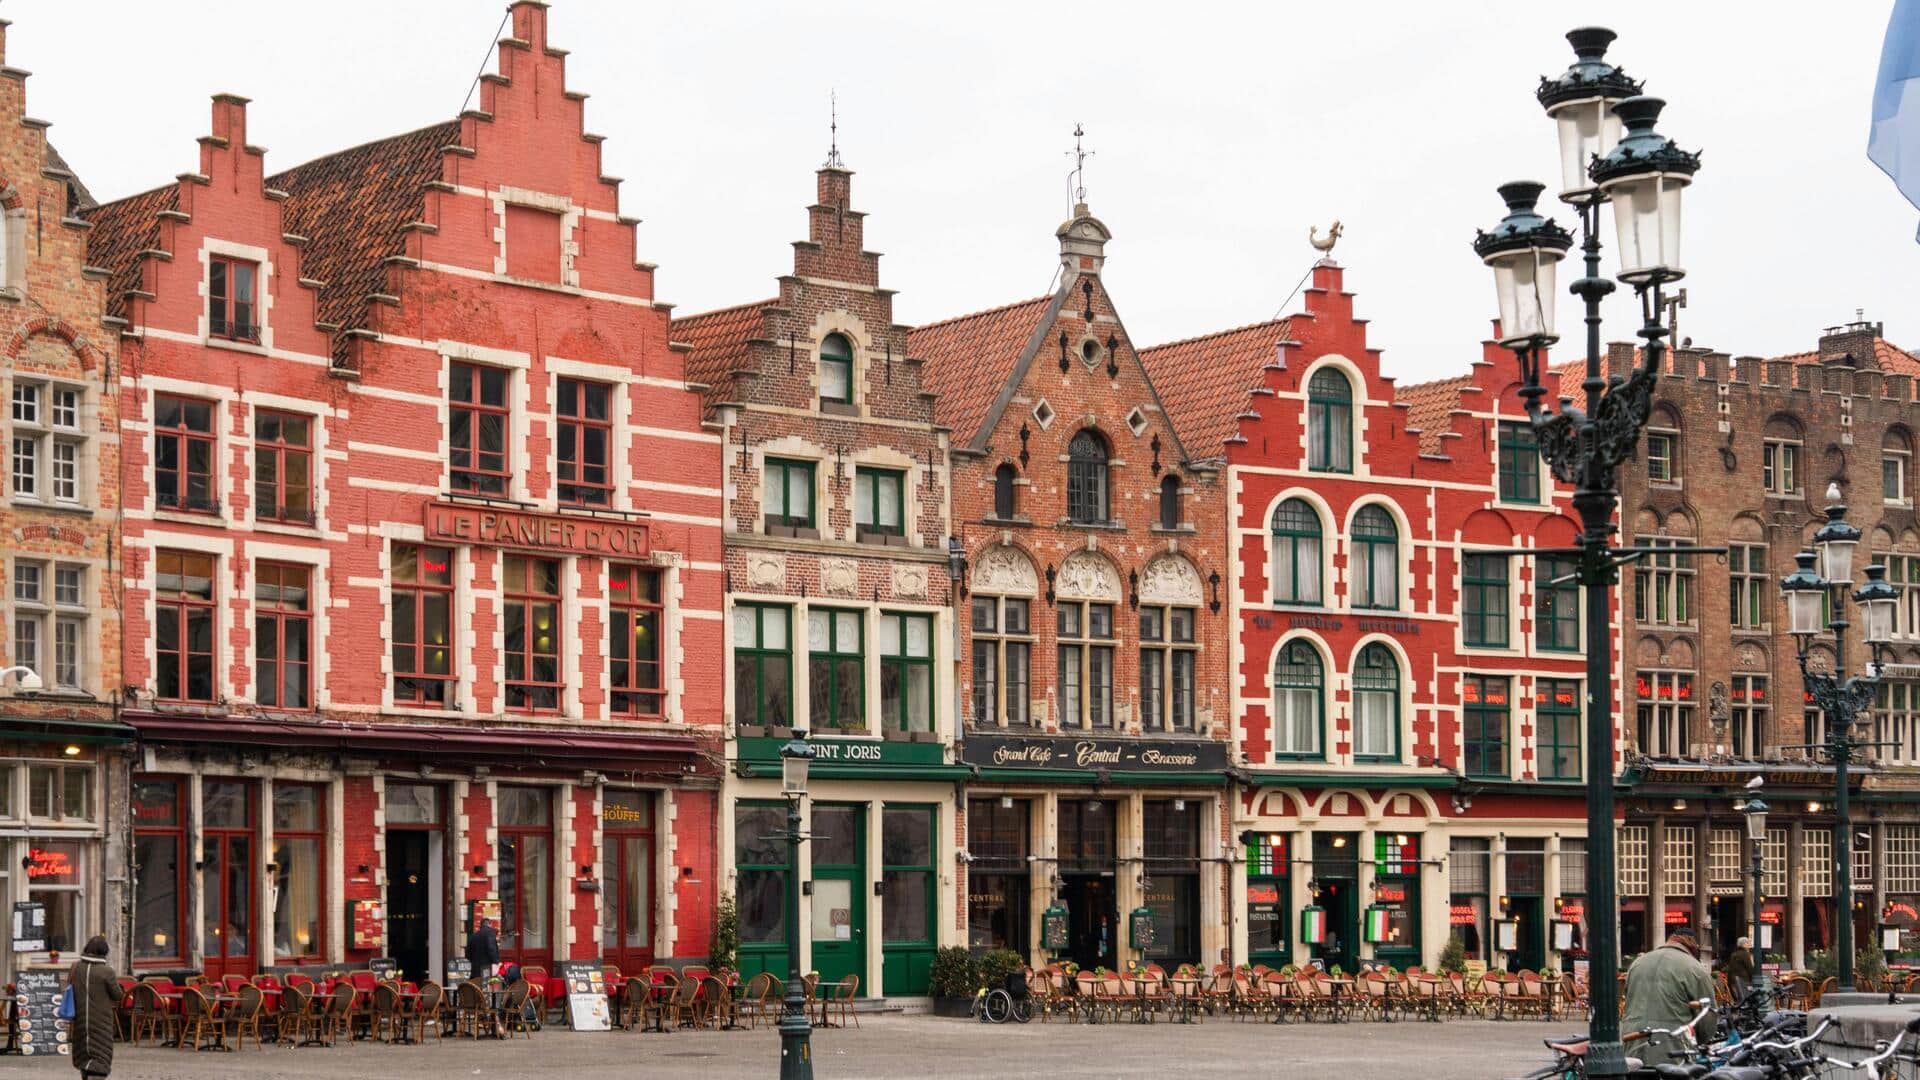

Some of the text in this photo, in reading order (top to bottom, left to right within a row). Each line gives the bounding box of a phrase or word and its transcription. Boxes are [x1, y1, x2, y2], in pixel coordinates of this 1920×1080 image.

[437, 511, 472, 539] LE
[479, 512, 577, 549] PANIER
[844, 745, 882, 760] JORIS
[993, 745, 1029, 765] Grand
[1075, 741, 1122, 767] Central
[1141, 749, 1198, 766] Brasserie
[602, 809, 641, 822] HOUFFE
[968, 894, 1005, 903] CENTRAL
